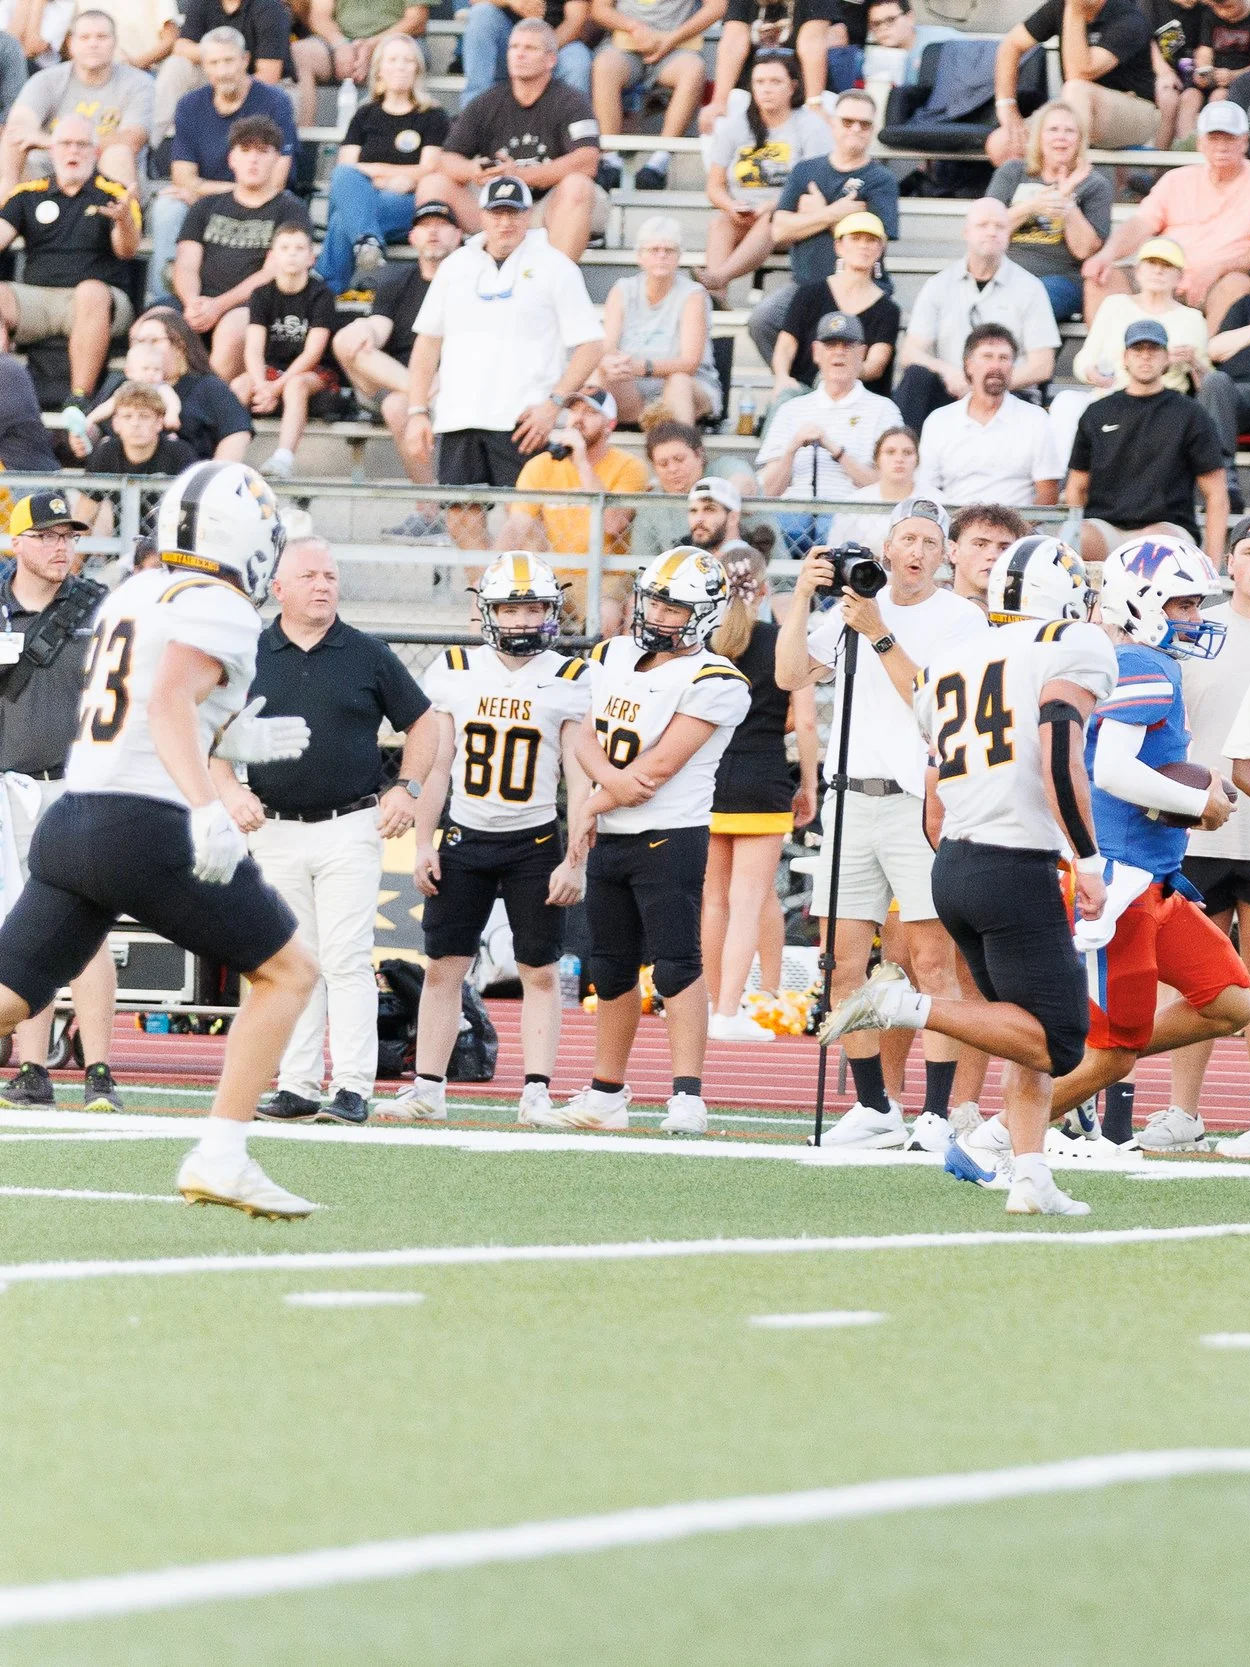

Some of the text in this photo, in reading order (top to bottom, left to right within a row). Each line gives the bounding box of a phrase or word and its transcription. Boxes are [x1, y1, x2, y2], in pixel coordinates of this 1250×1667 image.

[1124, 540, 1176, 582] N
[477, 694, 532, 722] NEERS
[935, 658, 1018, 785] 24
[464, 719, 543, 803] 80
